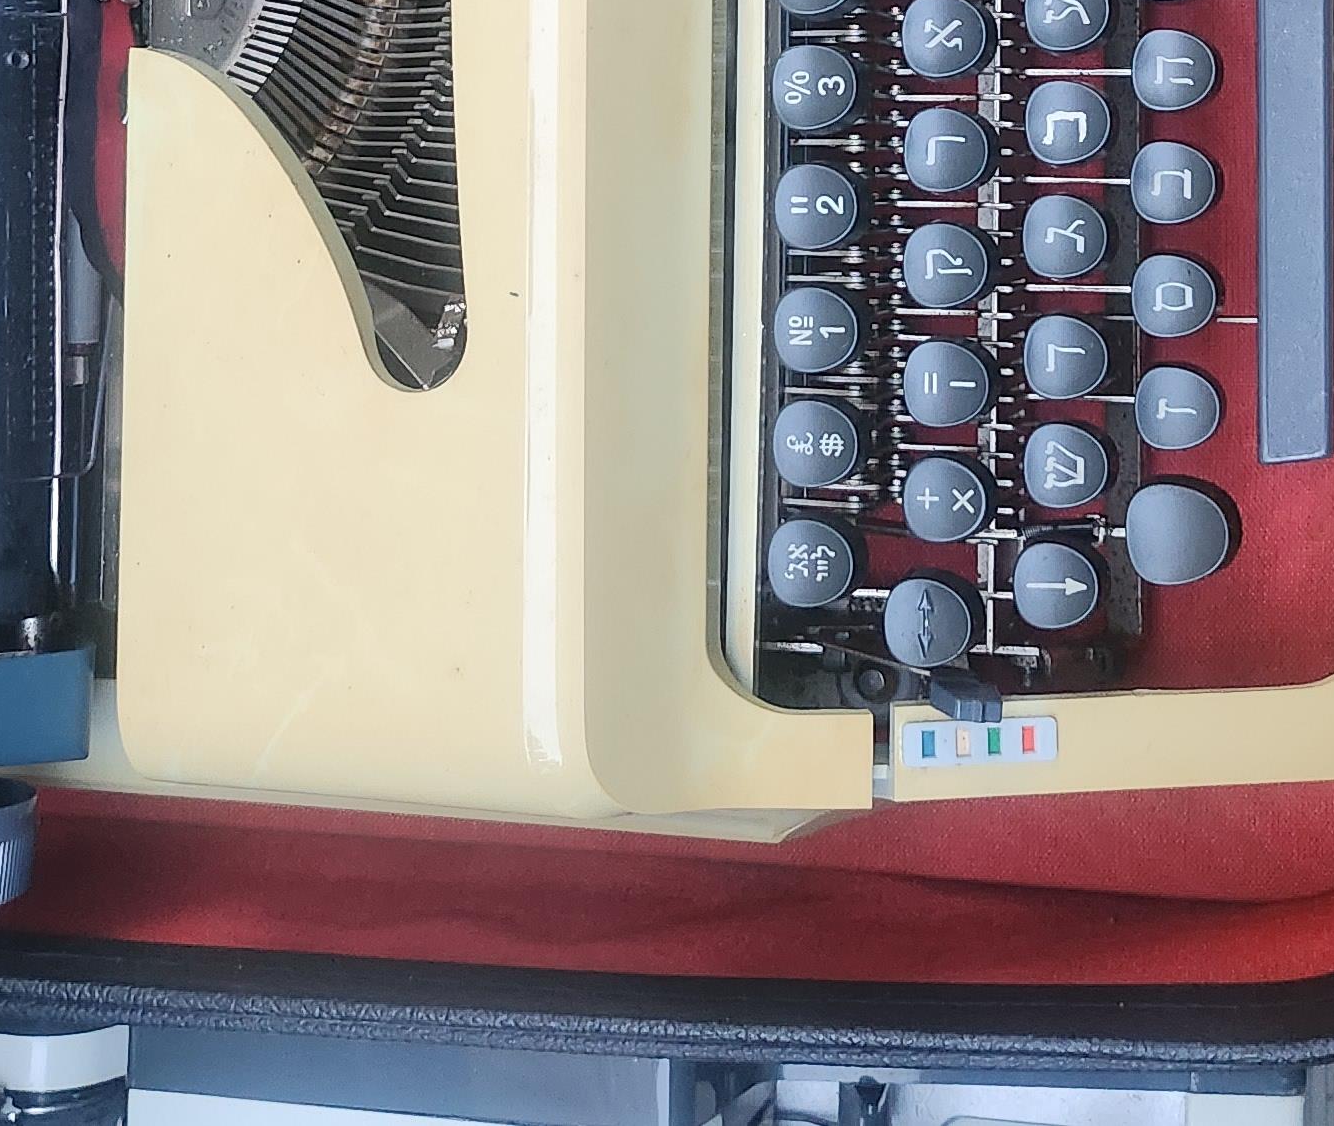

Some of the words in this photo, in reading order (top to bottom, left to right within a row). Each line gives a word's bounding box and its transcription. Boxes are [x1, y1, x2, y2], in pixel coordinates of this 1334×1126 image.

[922, 18, 963, 52] א
[817, 75, 846, 96] 3
[1153, 54, 1194, 86] ה
[783, 70, 812, 105] %
[925, 133, 966, 167] ר
[1150, 168, 1192, 200] ב
[815, 195, 844, 215] 2
[1044, 219, 1085, 254] ג
[923, 247, 973, 280] ק
[1152, 282, 1194, 312] ס
[1044, 341, 1086, 373] ד
[786, 432, 814, 456] £
[818, 433, 845, 457] $
[1043, 439, 1085, 490] ש
